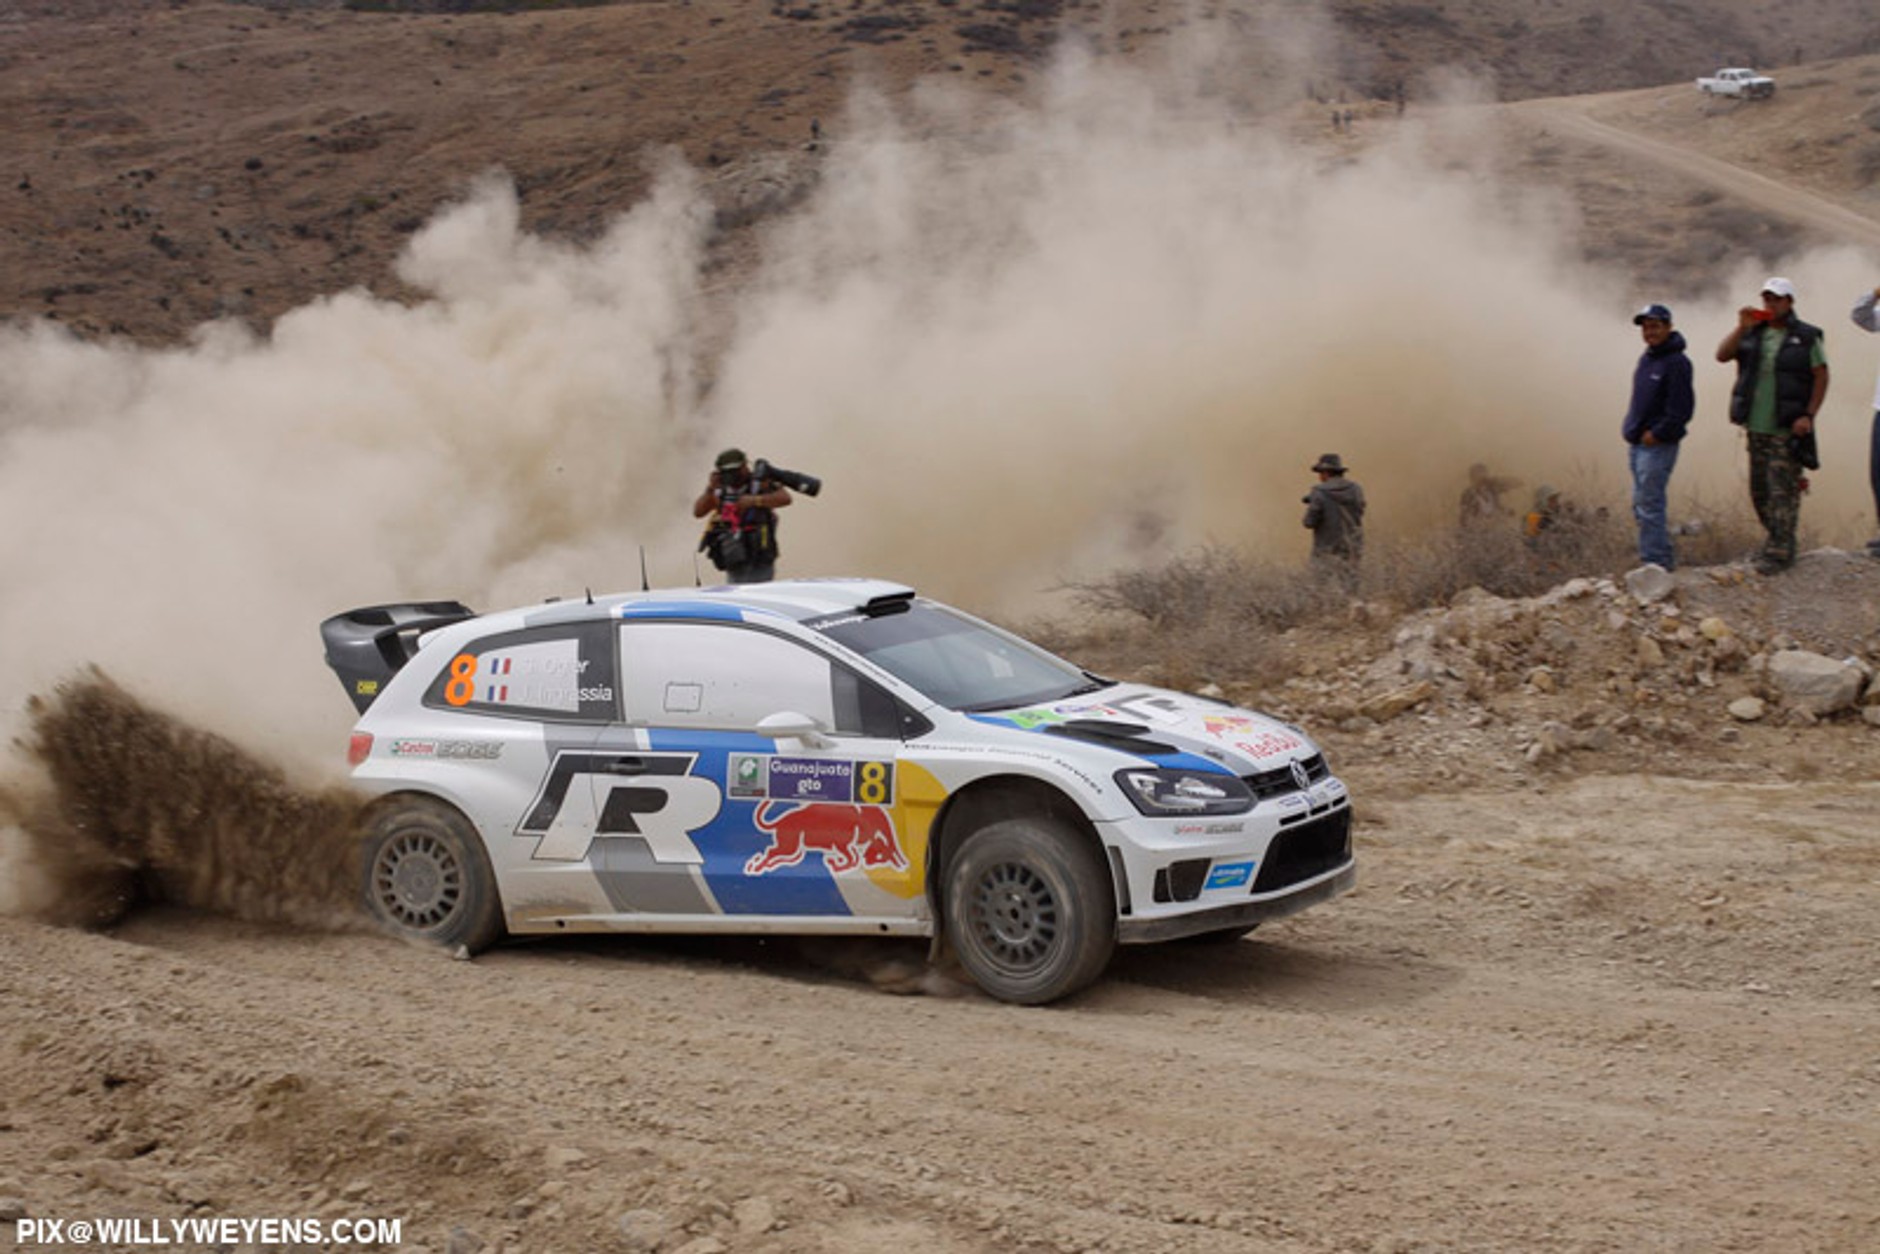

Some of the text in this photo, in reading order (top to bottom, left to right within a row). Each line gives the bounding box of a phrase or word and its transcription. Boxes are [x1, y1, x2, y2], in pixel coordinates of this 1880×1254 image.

[444, 653, 478, 707] 8
[770, 760, 850, 778] Guanajuato
[859, 761, 886, 804] 8
[531, 771, 723, 864] R
